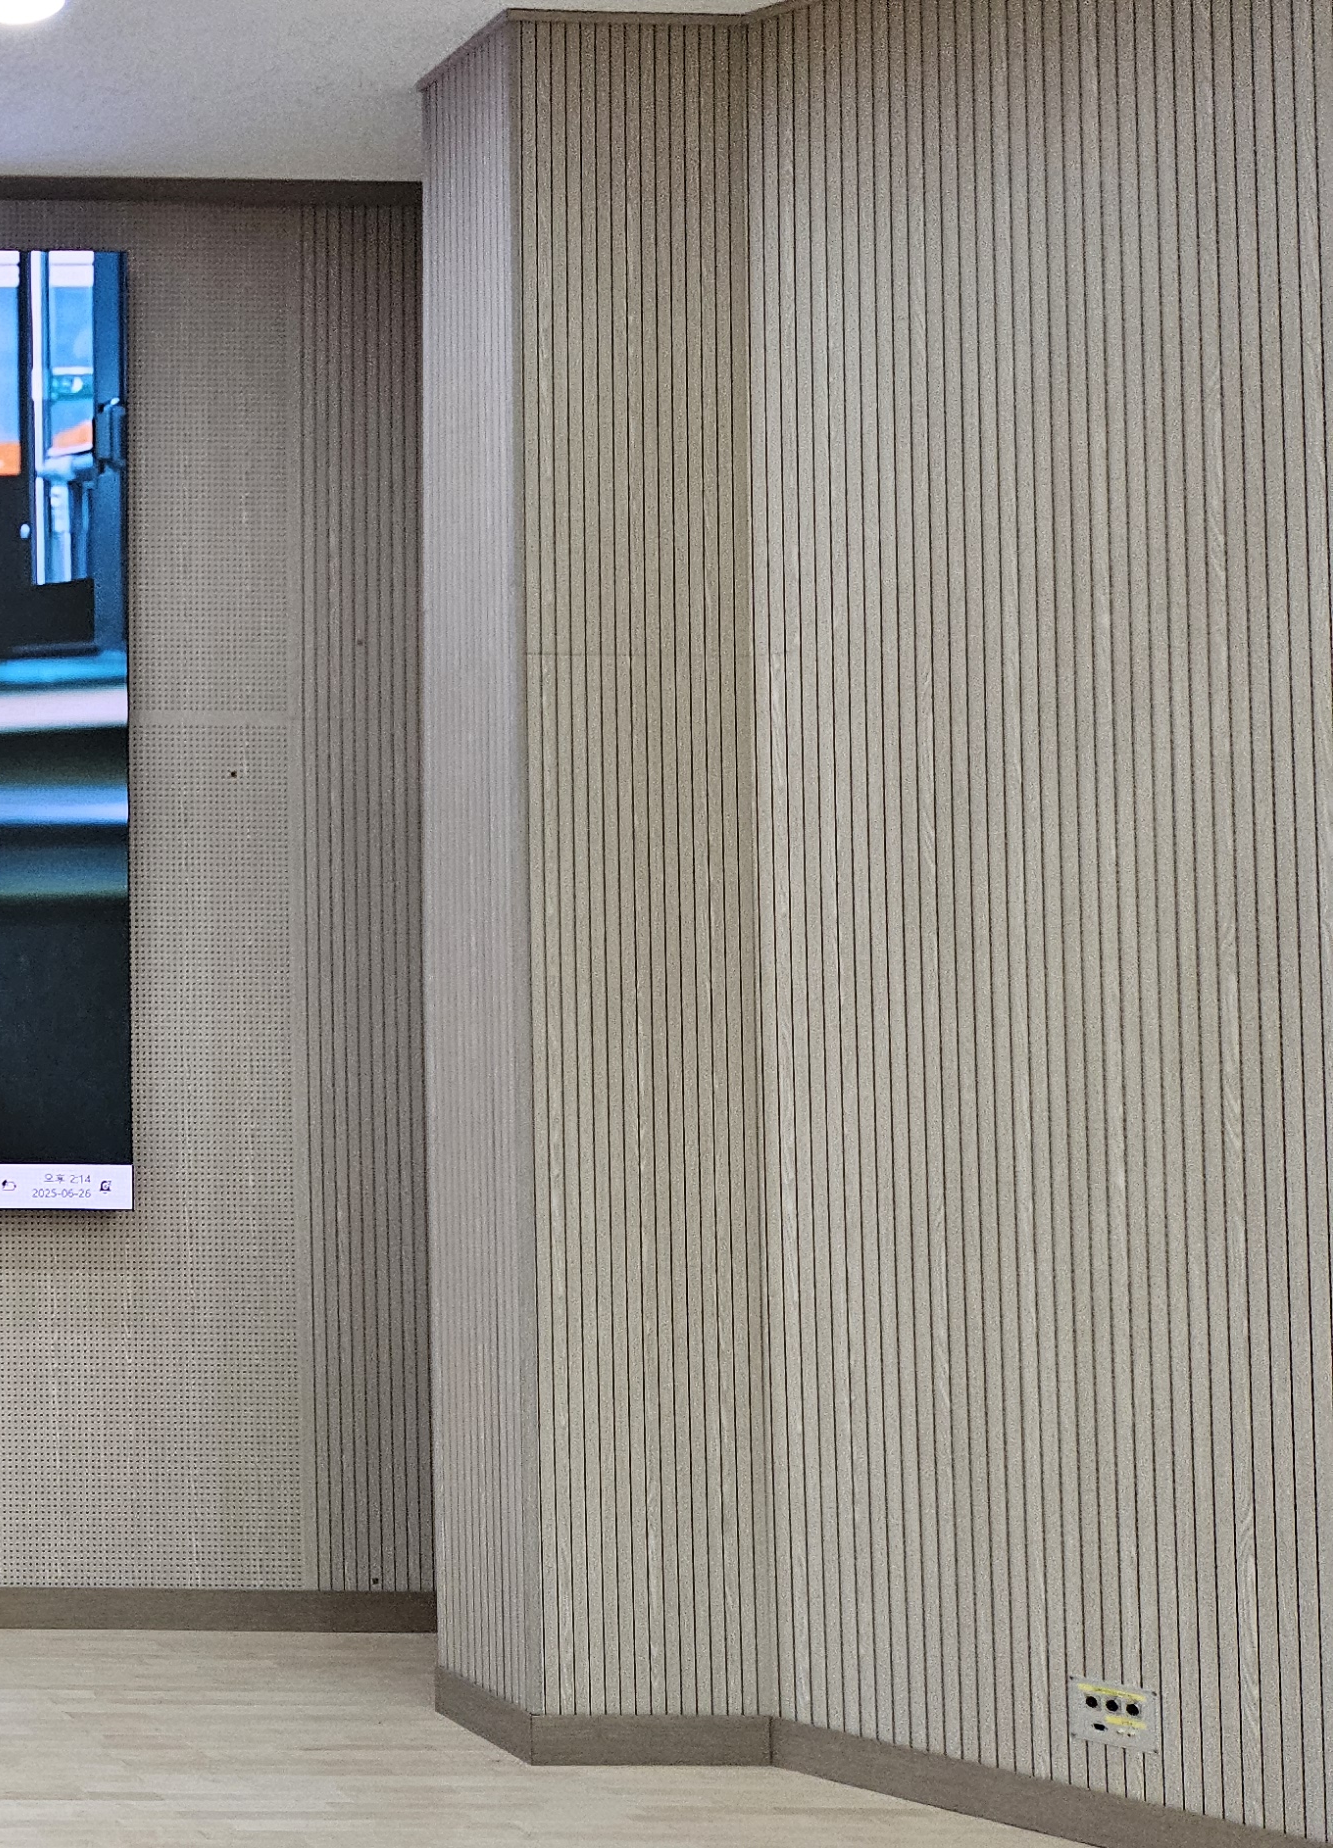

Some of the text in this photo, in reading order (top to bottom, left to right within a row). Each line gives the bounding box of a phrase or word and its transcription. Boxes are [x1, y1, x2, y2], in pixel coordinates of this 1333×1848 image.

[43, 1173, 92, 1184] 오후 2:14
[32, 1188, 92, 1199] 2025-06-26
